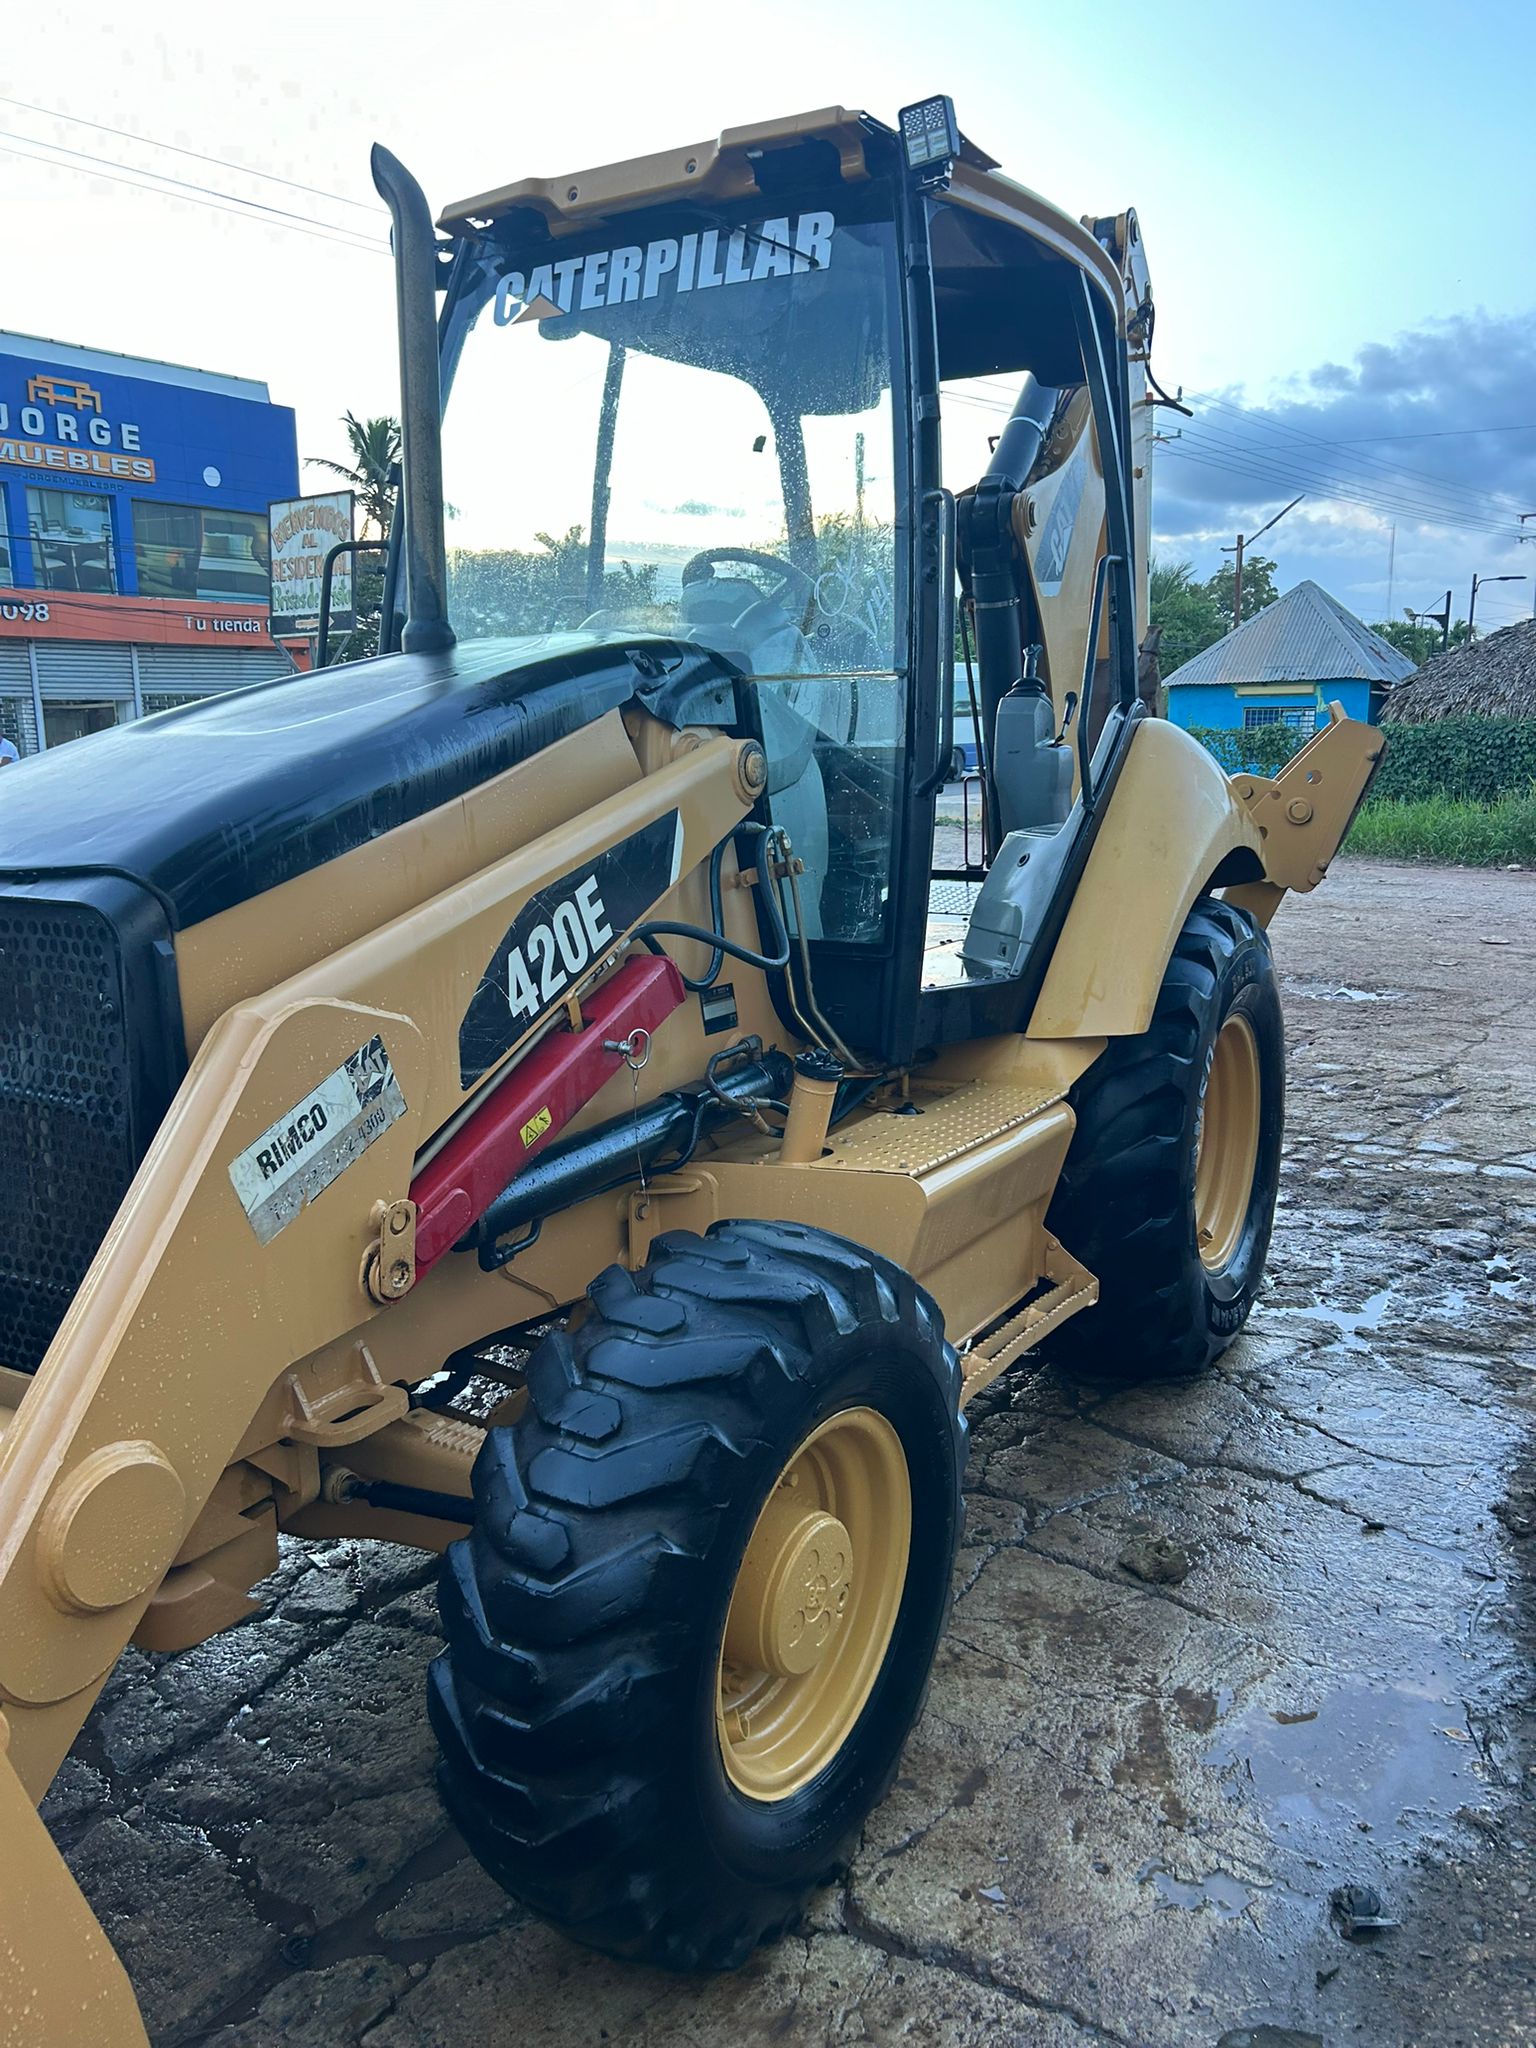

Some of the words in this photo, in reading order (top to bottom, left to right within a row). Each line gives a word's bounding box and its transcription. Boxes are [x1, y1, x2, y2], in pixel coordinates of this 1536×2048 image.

[493, 211, 835, 326] CATERPILLAR
[0, 442, 152, 478] MUEBLES
[302, 533, 318, 549] AL
[272, 553, 351, 583] RESIDENAL
[0, 603, 50, 622] 098
[185, 616, 206, 631] Tu
[212, 617, 261, 633] tienda
[508, 874, 613, 1018] 420E
[256, 1103, 328, 1180] RIMCO
